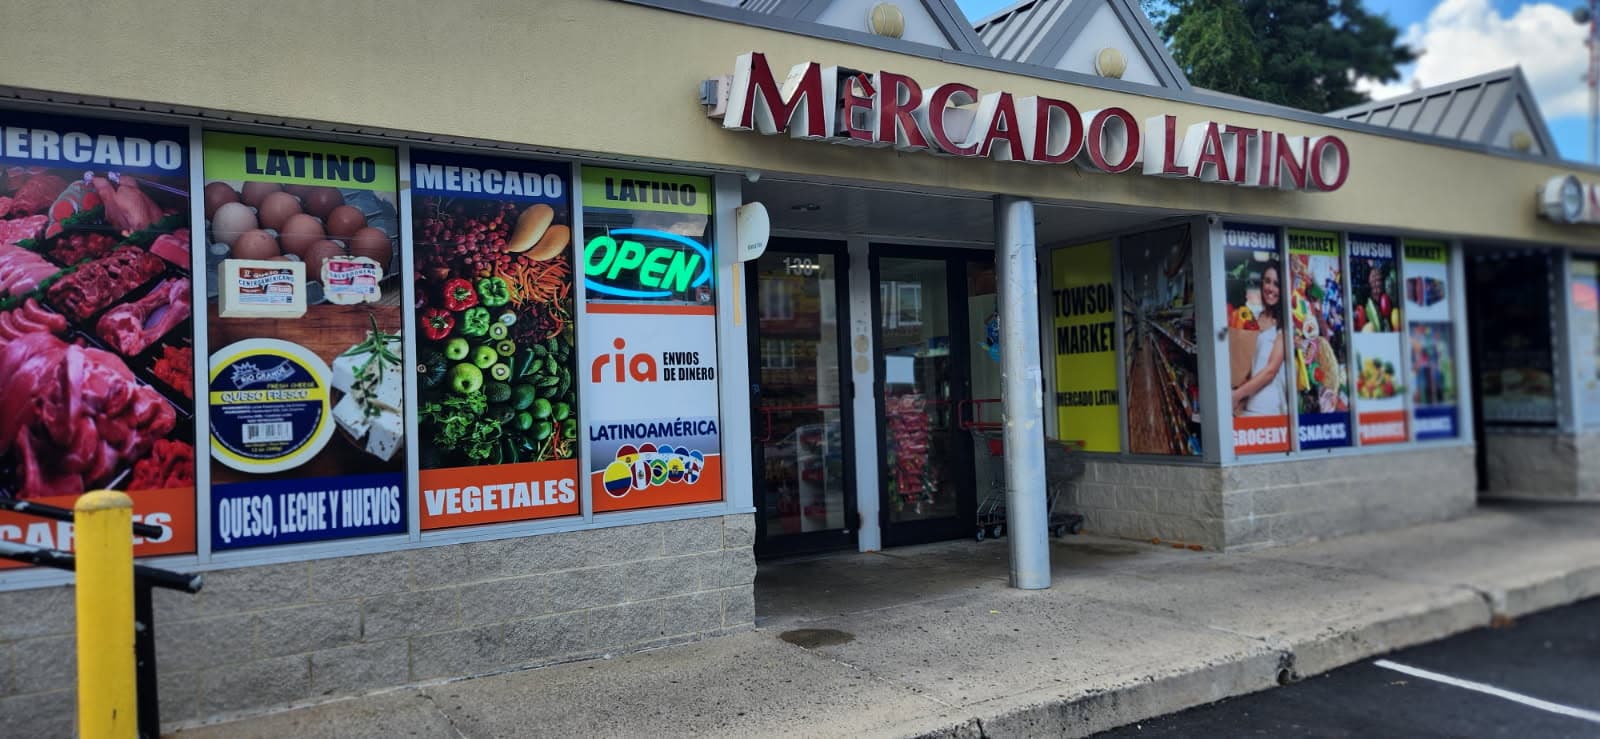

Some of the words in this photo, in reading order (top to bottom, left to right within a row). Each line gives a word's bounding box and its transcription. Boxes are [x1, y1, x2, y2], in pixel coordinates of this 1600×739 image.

[0, 126, 182, 170] ERCADO
[1161, 115, 1350, 191] LATINO
[245, 147, 376, 183] LATINO
[415, 164, 562, 198] MERCADO
[605, 177, 697, 207] LATINO
[1289, 233, 1334, 252] MARKET
[584, 236, 701, 292] OPEN
[1052, 283, 1115, 318] TOWSON
[1057, 322, 1115, 355] MARKET
[591, 337, 658, 383] ria
[663, 351, 700, 366] ENVIOS
[663, 367, 676, 382] DE
[678, 367, 715, 381] DINERO
[222, 390, 264, 403] QUESO
[266, 389, 309, 400] FRESCO
[1056, 390, 1094, 407] MERCADO
[589, 417, 717, 441] LATINOAMÉRICA
[1299, 423, 1346, 442] SNACKS
[219, 495, 278, 543] QUESO,
[280, 492, 327, 533] LECHE
[328, 490, 339, 529] Y
[341, 485, 400, 528] HUEVOS
[424, 479, 576, 517] VEGETALES
